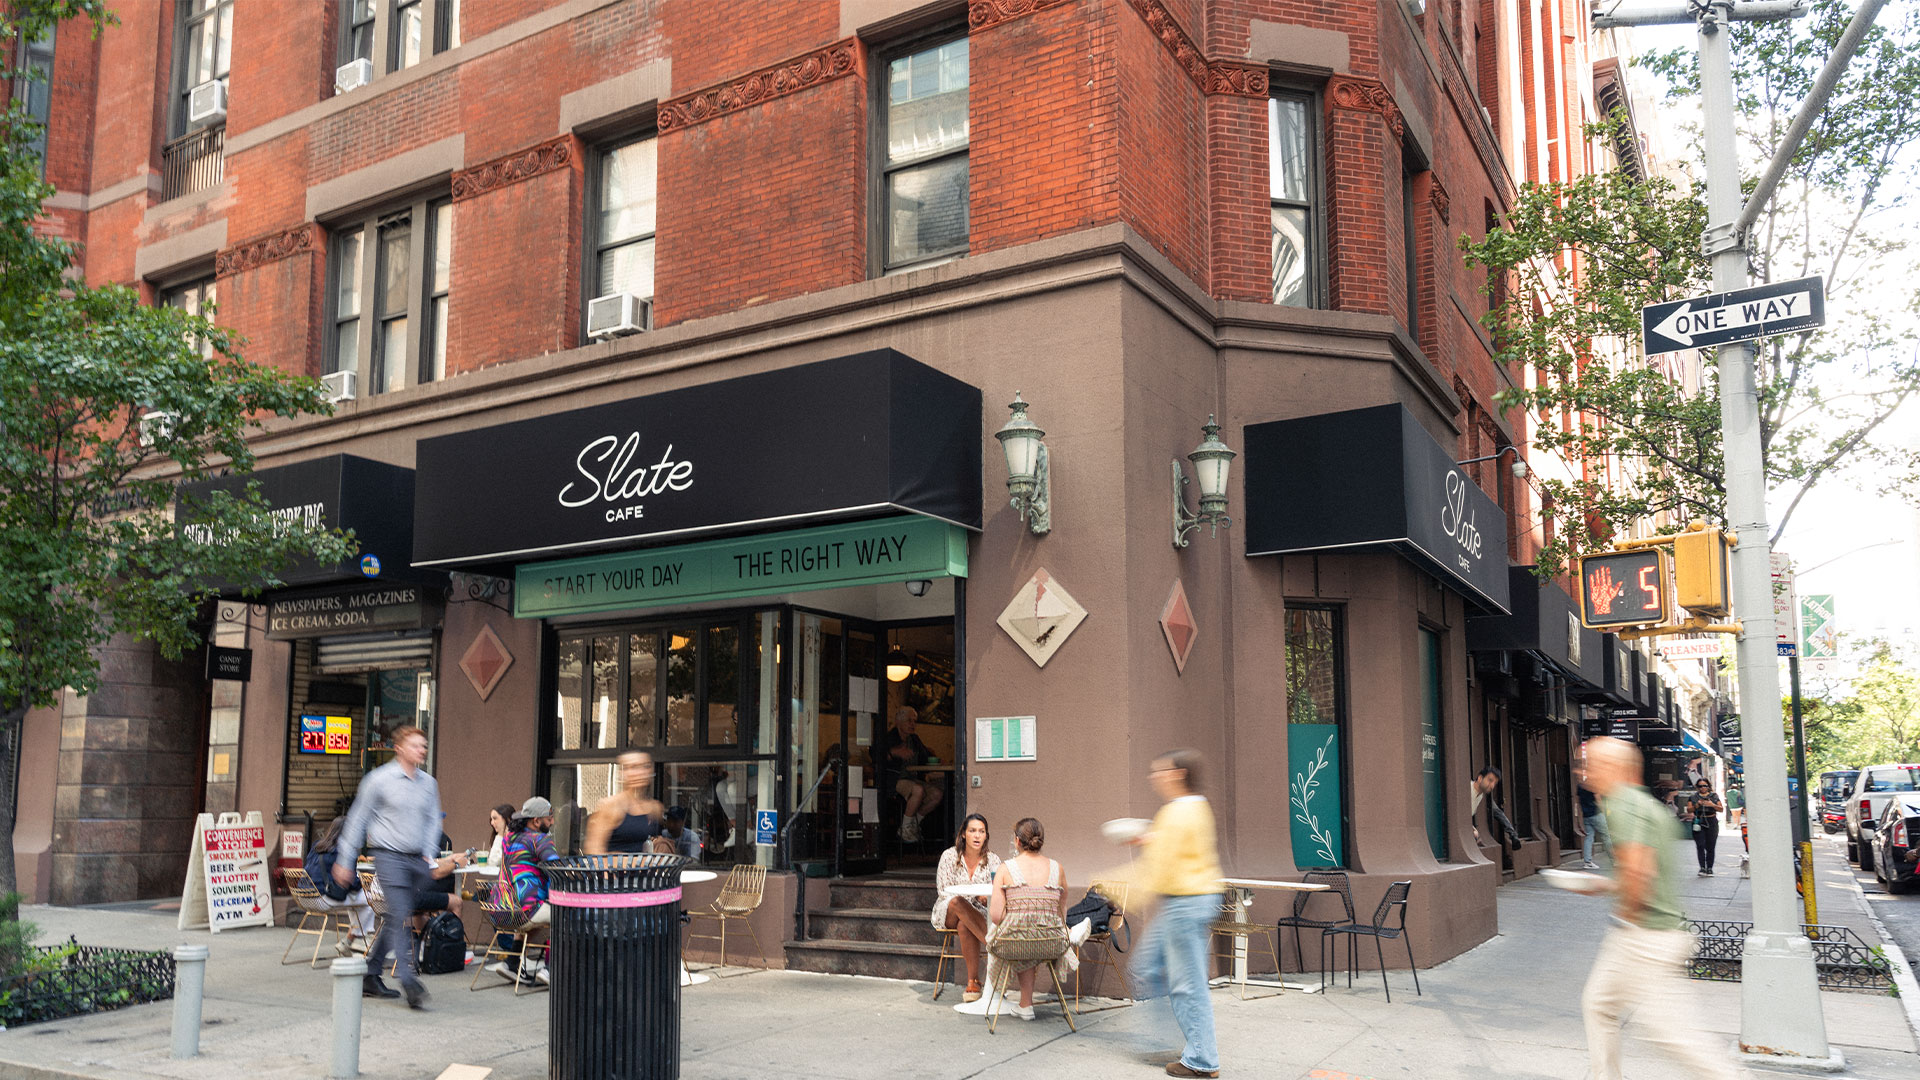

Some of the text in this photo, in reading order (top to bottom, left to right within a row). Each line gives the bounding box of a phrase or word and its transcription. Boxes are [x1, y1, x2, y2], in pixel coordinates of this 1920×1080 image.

[1676, 296, 1797, 335] ONE WAY
[1767, 322, 1819, 334] TRANSPORTATION
[558, 431, 694, 508] Slate
[605, 505, 644, 523] CAFE
[1441, 470, 1482, 560] Slate
[734, 534, 908, 578] THE RIGHT WAY
[1458, 554, 1471, 574] CAFE
[544, 562, 684, 598] START YOUR DAY
[1639, 565, 1659, 610] 5
[274, 589, 416, 615] NEWSPAPERS, MAGAZINES
[271, 611, 369, 631] ICE CREAM, SODA,
[1663, 643, 1719, 655] CLEANERS
[219, 655, 241, 665] CANDY
[219, 664, 240, 673] STORE
[303, 731, 349, 748] 277 850
[206, 829, 263, 842] CONVENIENCE
[284, 834, 303, 844] STAND
[217, 841, 254, 851] STORE
[286, 846, 298, 855] PIPE
[209, 851, 258, 861] SMOKE, VAPE
[210, 864, 234, 873] BEER
[211, 872, 259, 884] NY LOTTERY
[212, 885, 251, 896] SOUVENIR
[213, 896, 253, 907] ICE-CREAM
[216, 910, 243, 921] ATM
